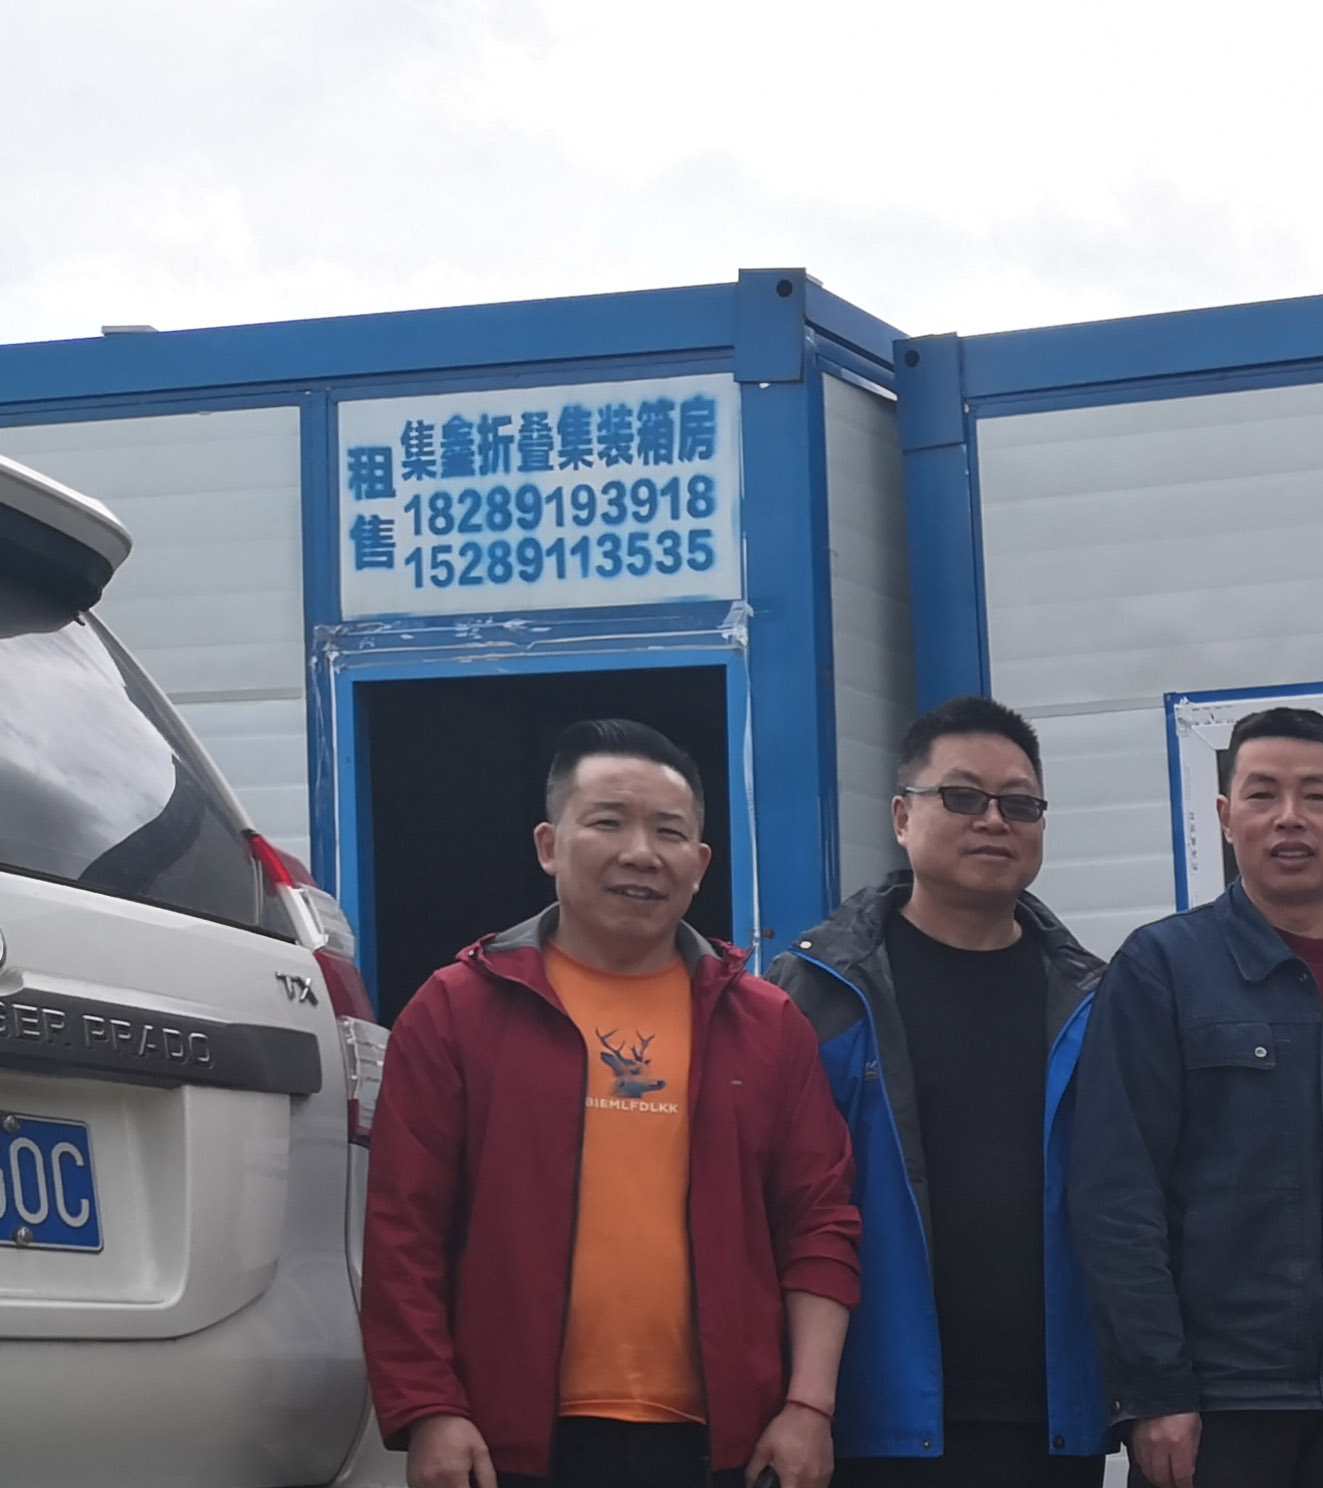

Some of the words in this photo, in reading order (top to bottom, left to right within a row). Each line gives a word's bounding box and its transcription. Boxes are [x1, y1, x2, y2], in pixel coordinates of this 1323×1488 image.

[400, 395, 718, 481] 集鑫折叠集装箱房
[403, 474, 716, 537] 18289193918
[403, 528, 715, 589] 15289113535
[0, 1002, 66, 1043] ER
[82, 1014, 216, 1071] PRADO
[0, 1137, 91, 1229] 0C
